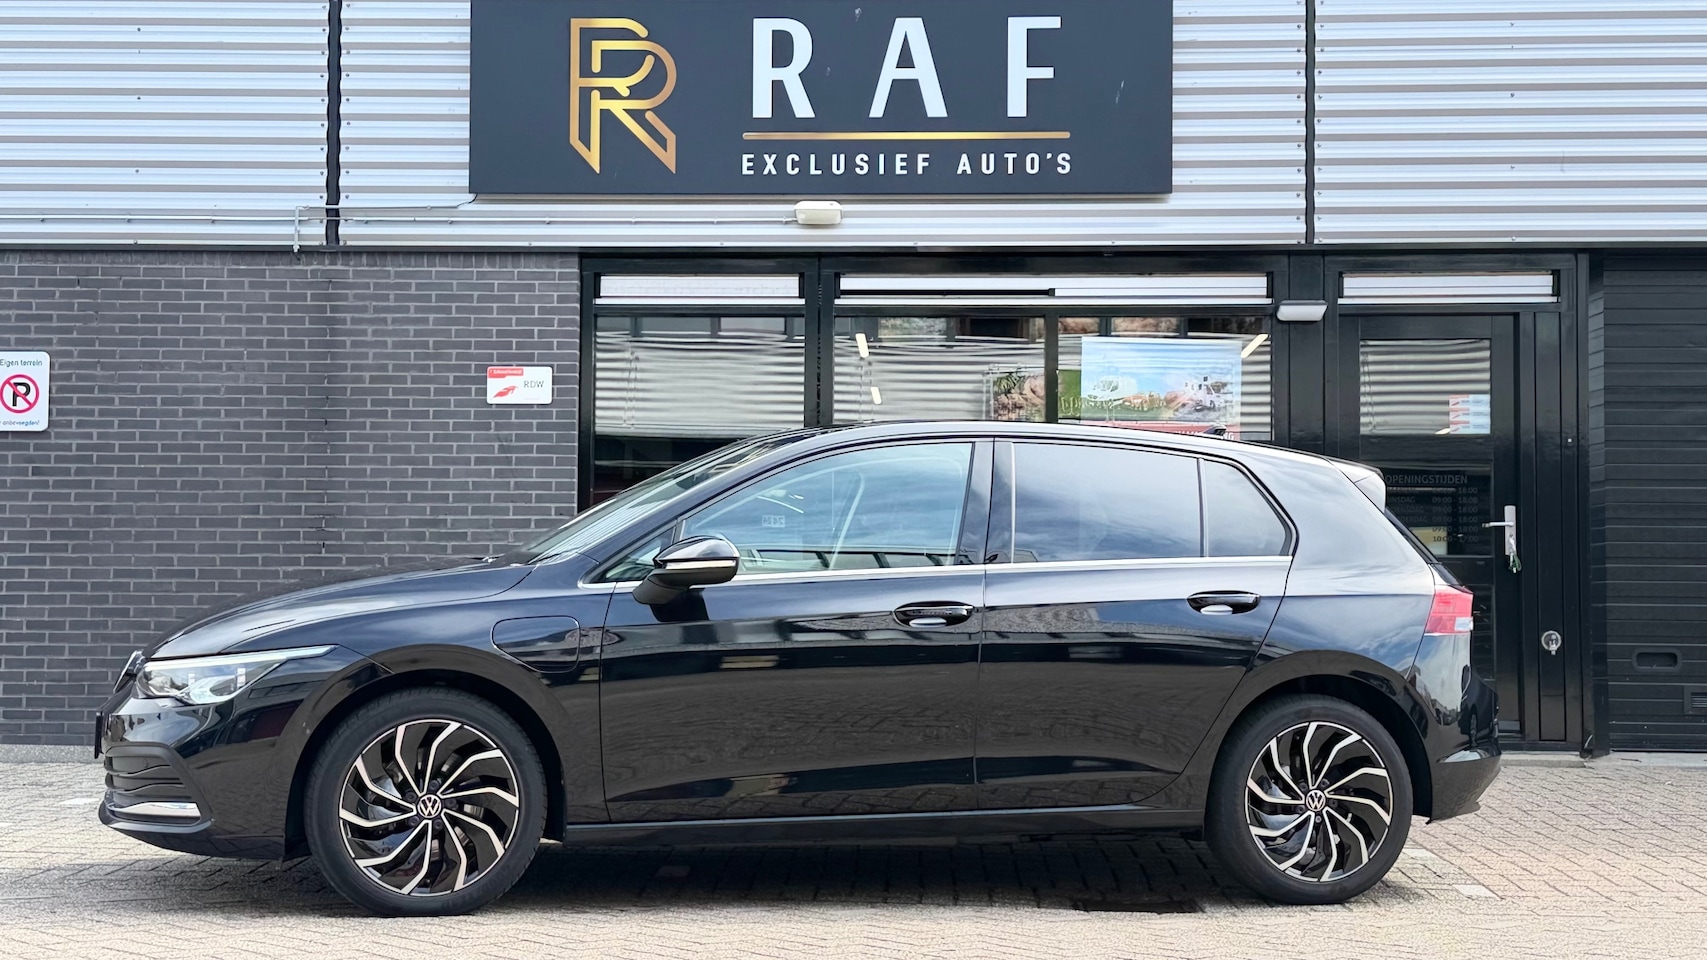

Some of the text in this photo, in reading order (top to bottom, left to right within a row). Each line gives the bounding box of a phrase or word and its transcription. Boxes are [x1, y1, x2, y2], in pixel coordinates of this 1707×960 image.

[752, 16, 1062, 118] RAF
[741, 152, 1071, 175] EXCLUSIEF AUTO'S
[1384, 474, 1468, 484] OPENINGSTIJDEN
